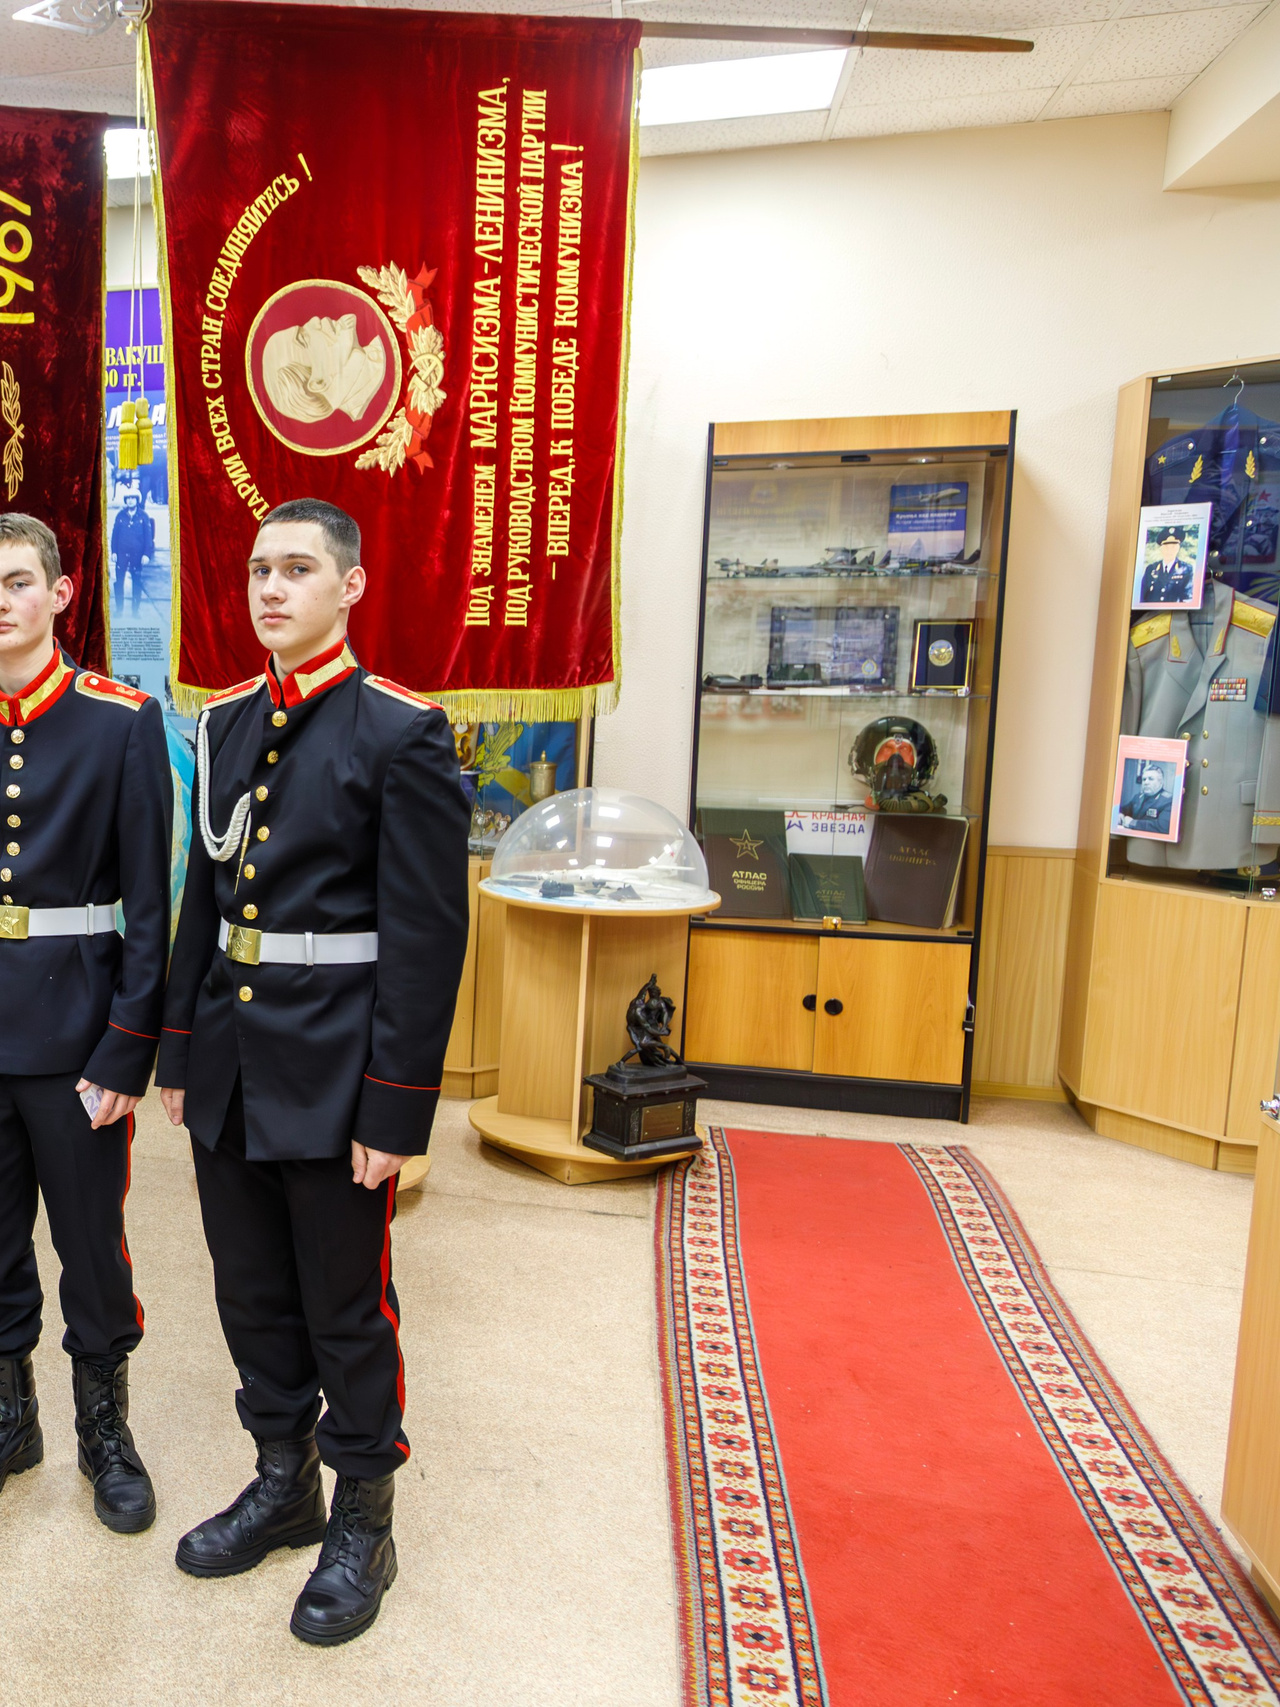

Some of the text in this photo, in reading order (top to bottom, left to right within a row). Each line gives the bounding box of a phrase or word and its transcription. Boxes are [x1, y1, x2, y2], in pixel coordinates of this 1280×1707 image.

[553, 160, 583, 329] КОММУНИЗМА
[505, 89, 547, 627] ПОД РУКОВОДСТВОМ КОММУНИСТИЧЕСКОЙ ПАРТИИ
[550, 337, 580, 430] ПОБЕДЕ
[206, 394, 236, 454] ВСЕХ
[471, 463, 496, 576] ЗНАМЕНЕМ
[465, 584, 495, 627] ПОД
[811, 822, 865, 835] ЗВЕЗДА
[812, 811, 866, 822] КРАСНАЯ
[732, 870, 767, 881] АТЛАС
